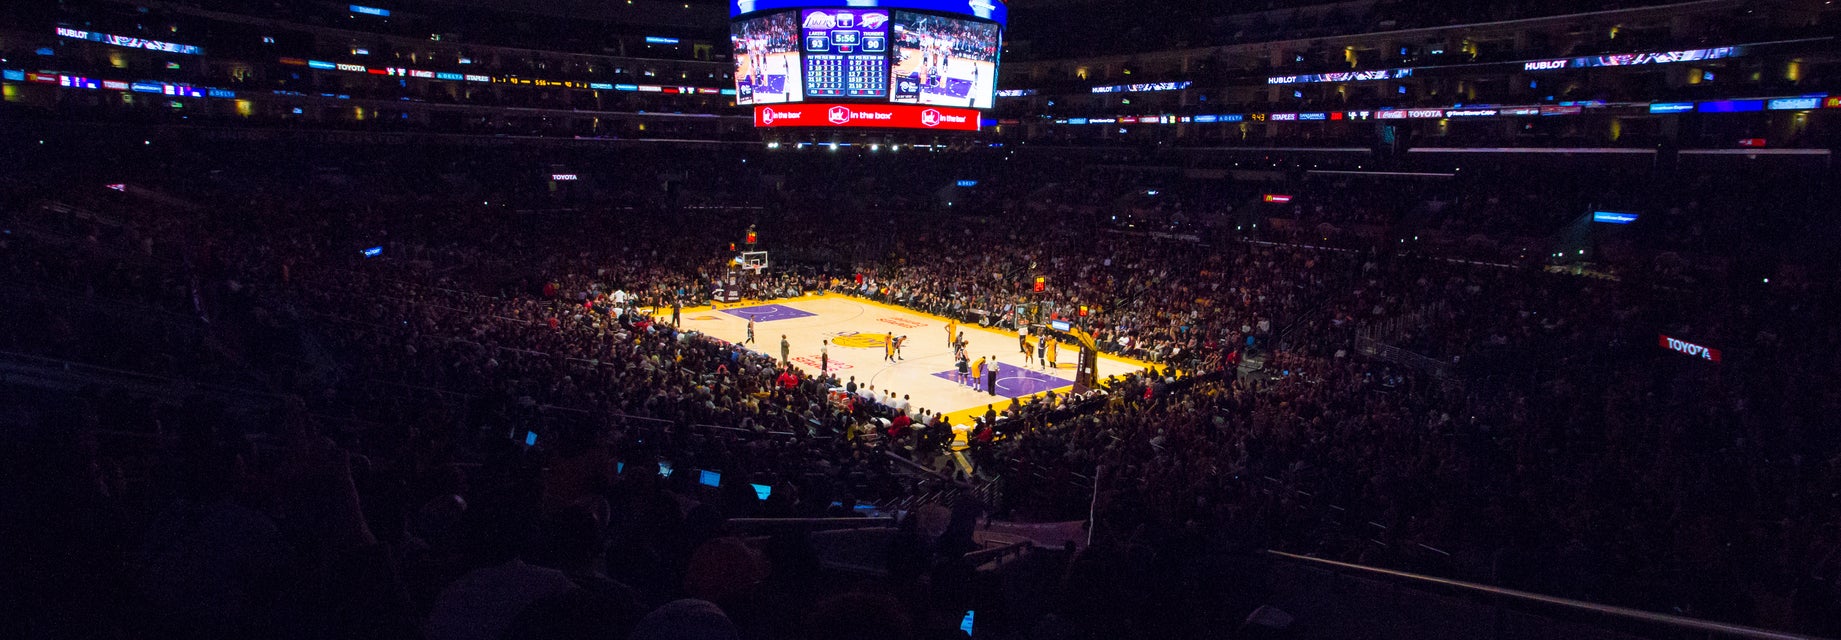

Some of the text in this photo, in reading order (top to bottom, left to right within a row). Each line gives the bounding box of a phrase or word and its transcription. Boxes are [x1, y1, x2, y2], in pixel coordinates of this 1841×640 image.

[57, 27, 89, 39] HUBLOT
[812, 40, 823, 48] 93
[868, 41, 879, 49] 90
[337, 63, 367, 73] TOYOTA
[1524, 60, 1567, 70] HUBLOT
[1408, 110, 1442, 118] TOYOTA
[1667, 337, 1711, 360] TOYOTA
